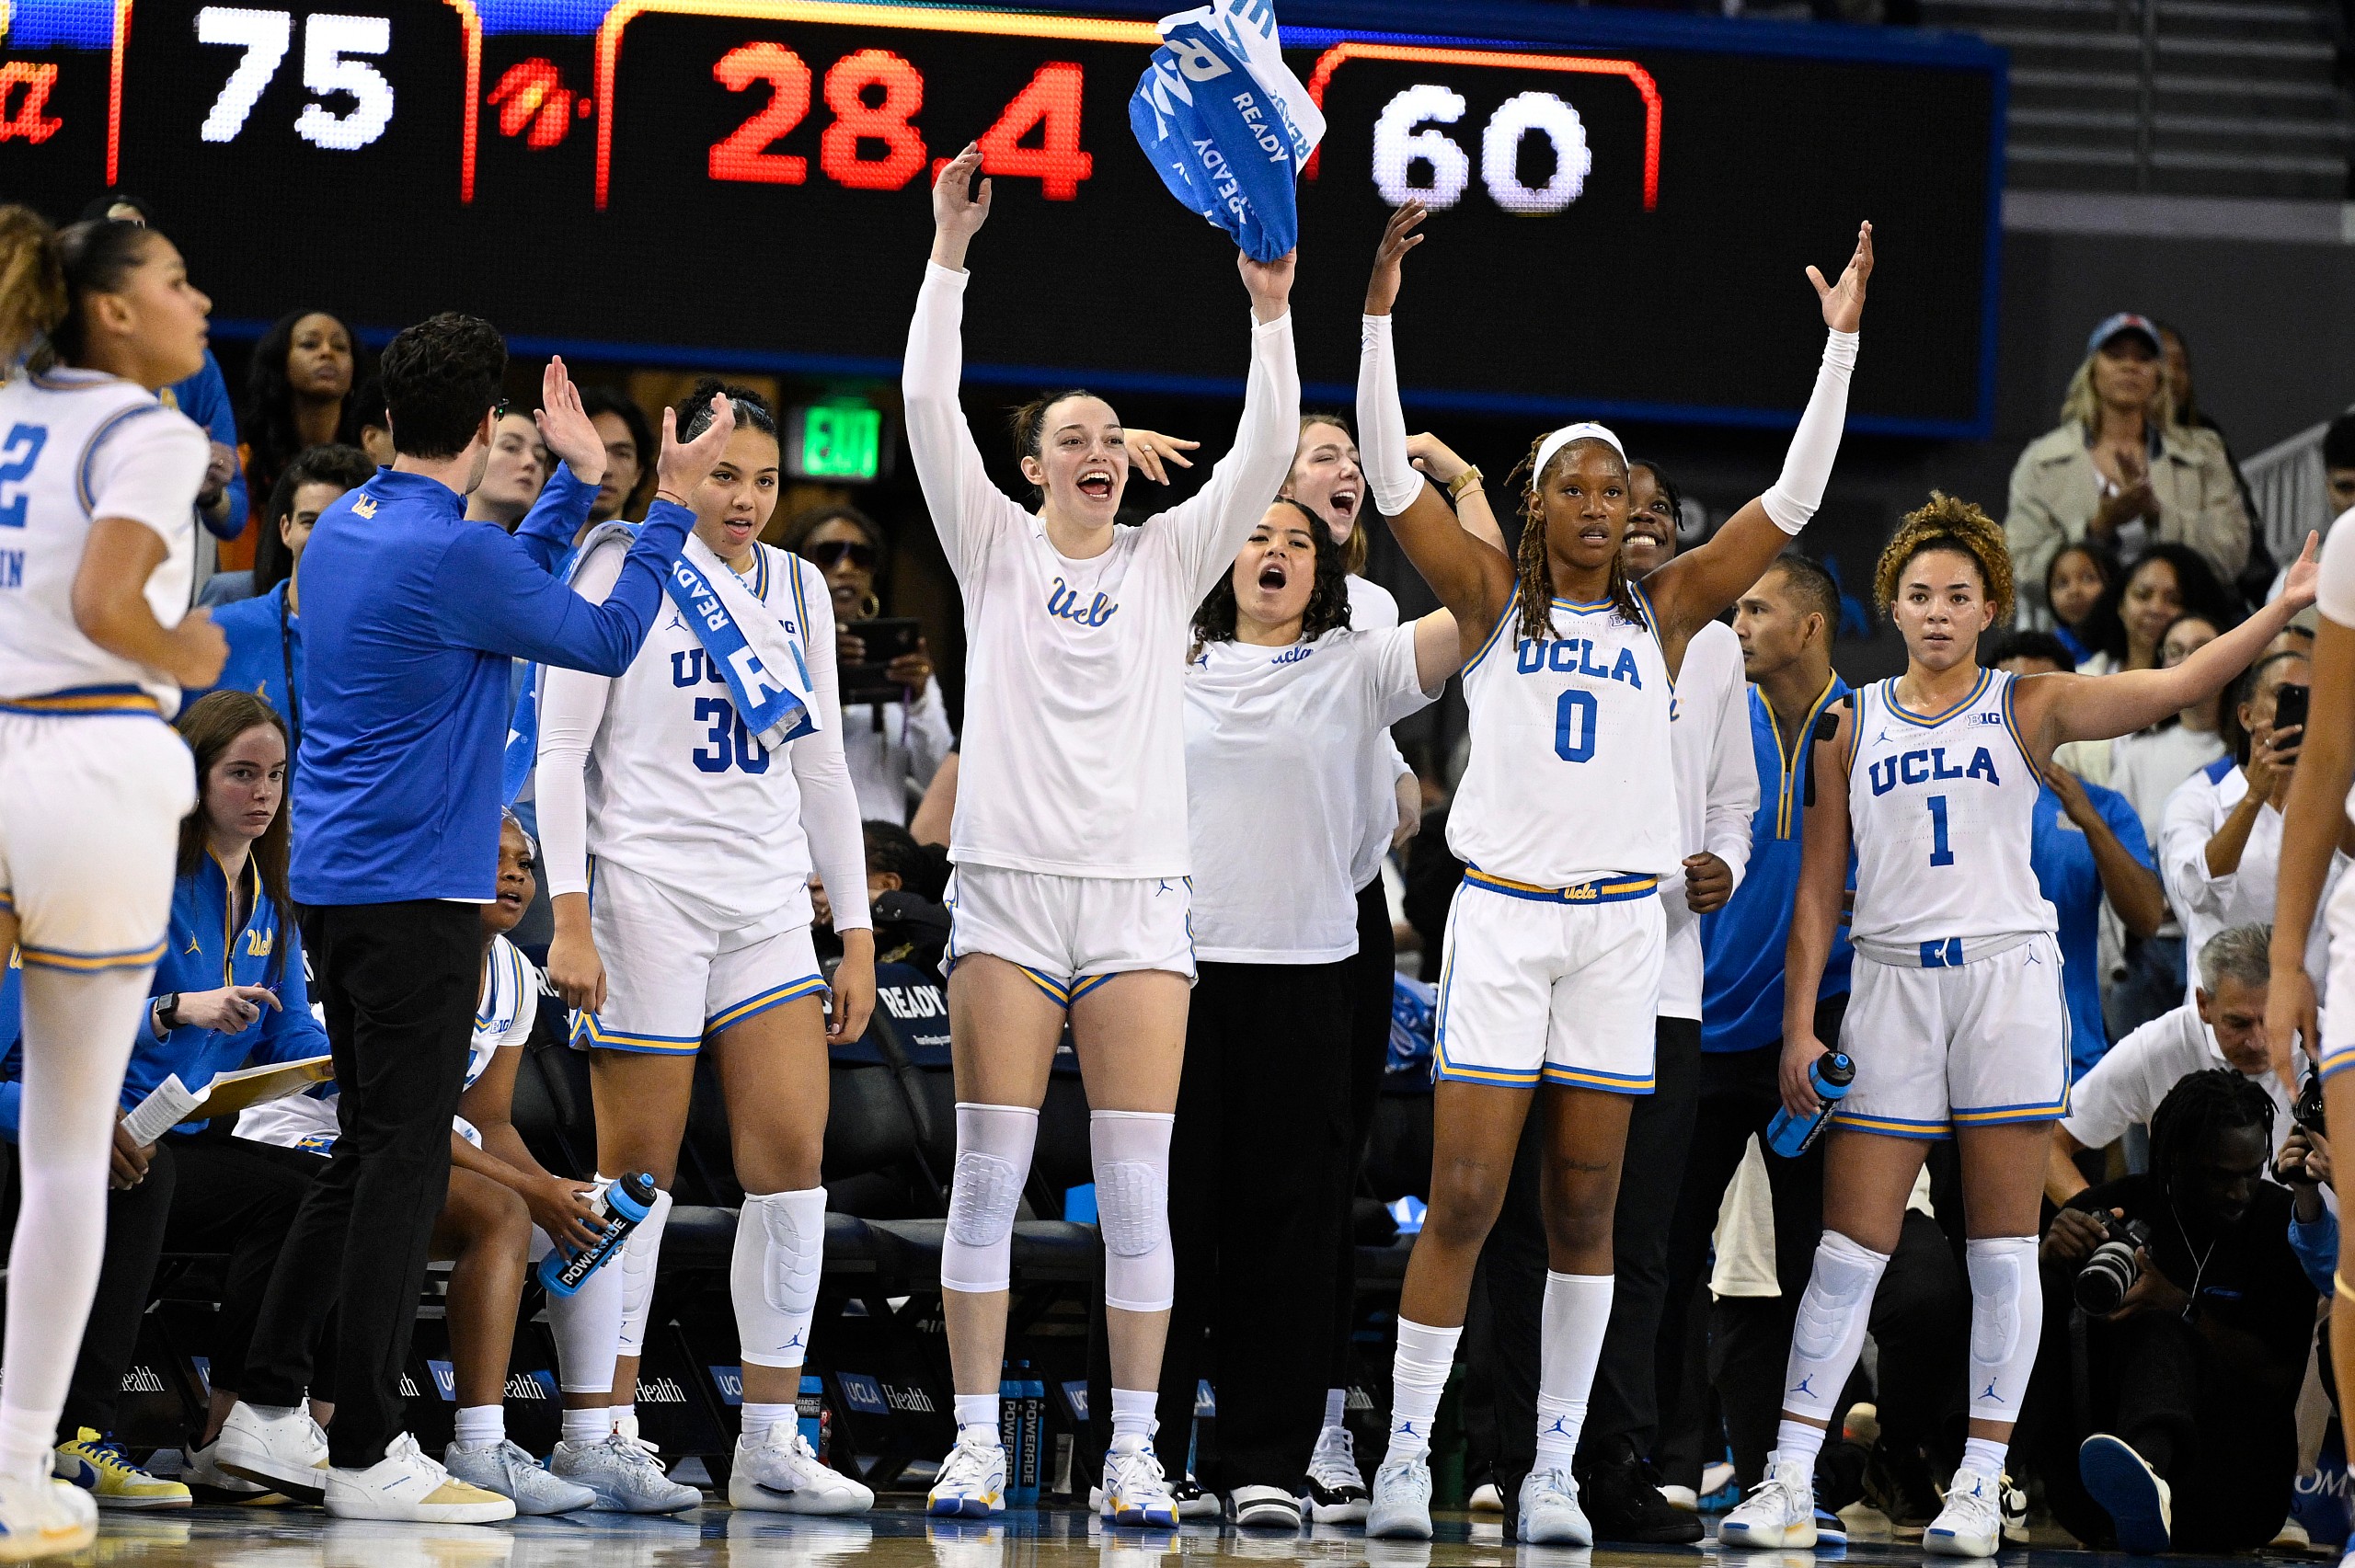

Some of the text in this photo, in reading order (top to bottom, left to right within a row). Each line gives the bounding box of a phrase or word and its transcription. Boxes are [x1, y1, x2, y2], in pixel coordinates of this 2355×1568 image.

[194, 6, 394, 150] 75
[708, 40, 1092, 201] 28.4
[1233, 92, 1289, 163] READY
[1373, 84, 1591, 213] 60
[673, 560, 729, 632] READY
[1517, 638, 1641, 691] UCLA
[693, 697, 769, 774] 30
[1555, 689, 1598, 763] 0
[1868, 747, 2000, 797] UCLA
[1927, 795, 1954, 866] 1
[247, 927, 273, 956] Ucl
[877, 985, 948, 1018] READY
[120, 1366, 165, 1392] ealth
[502, 1373, 546, 1400] ealth
[845, 1380, 936, 1413] UCLA Health
[1023, 1399, 1038, 1484] POWERADE
